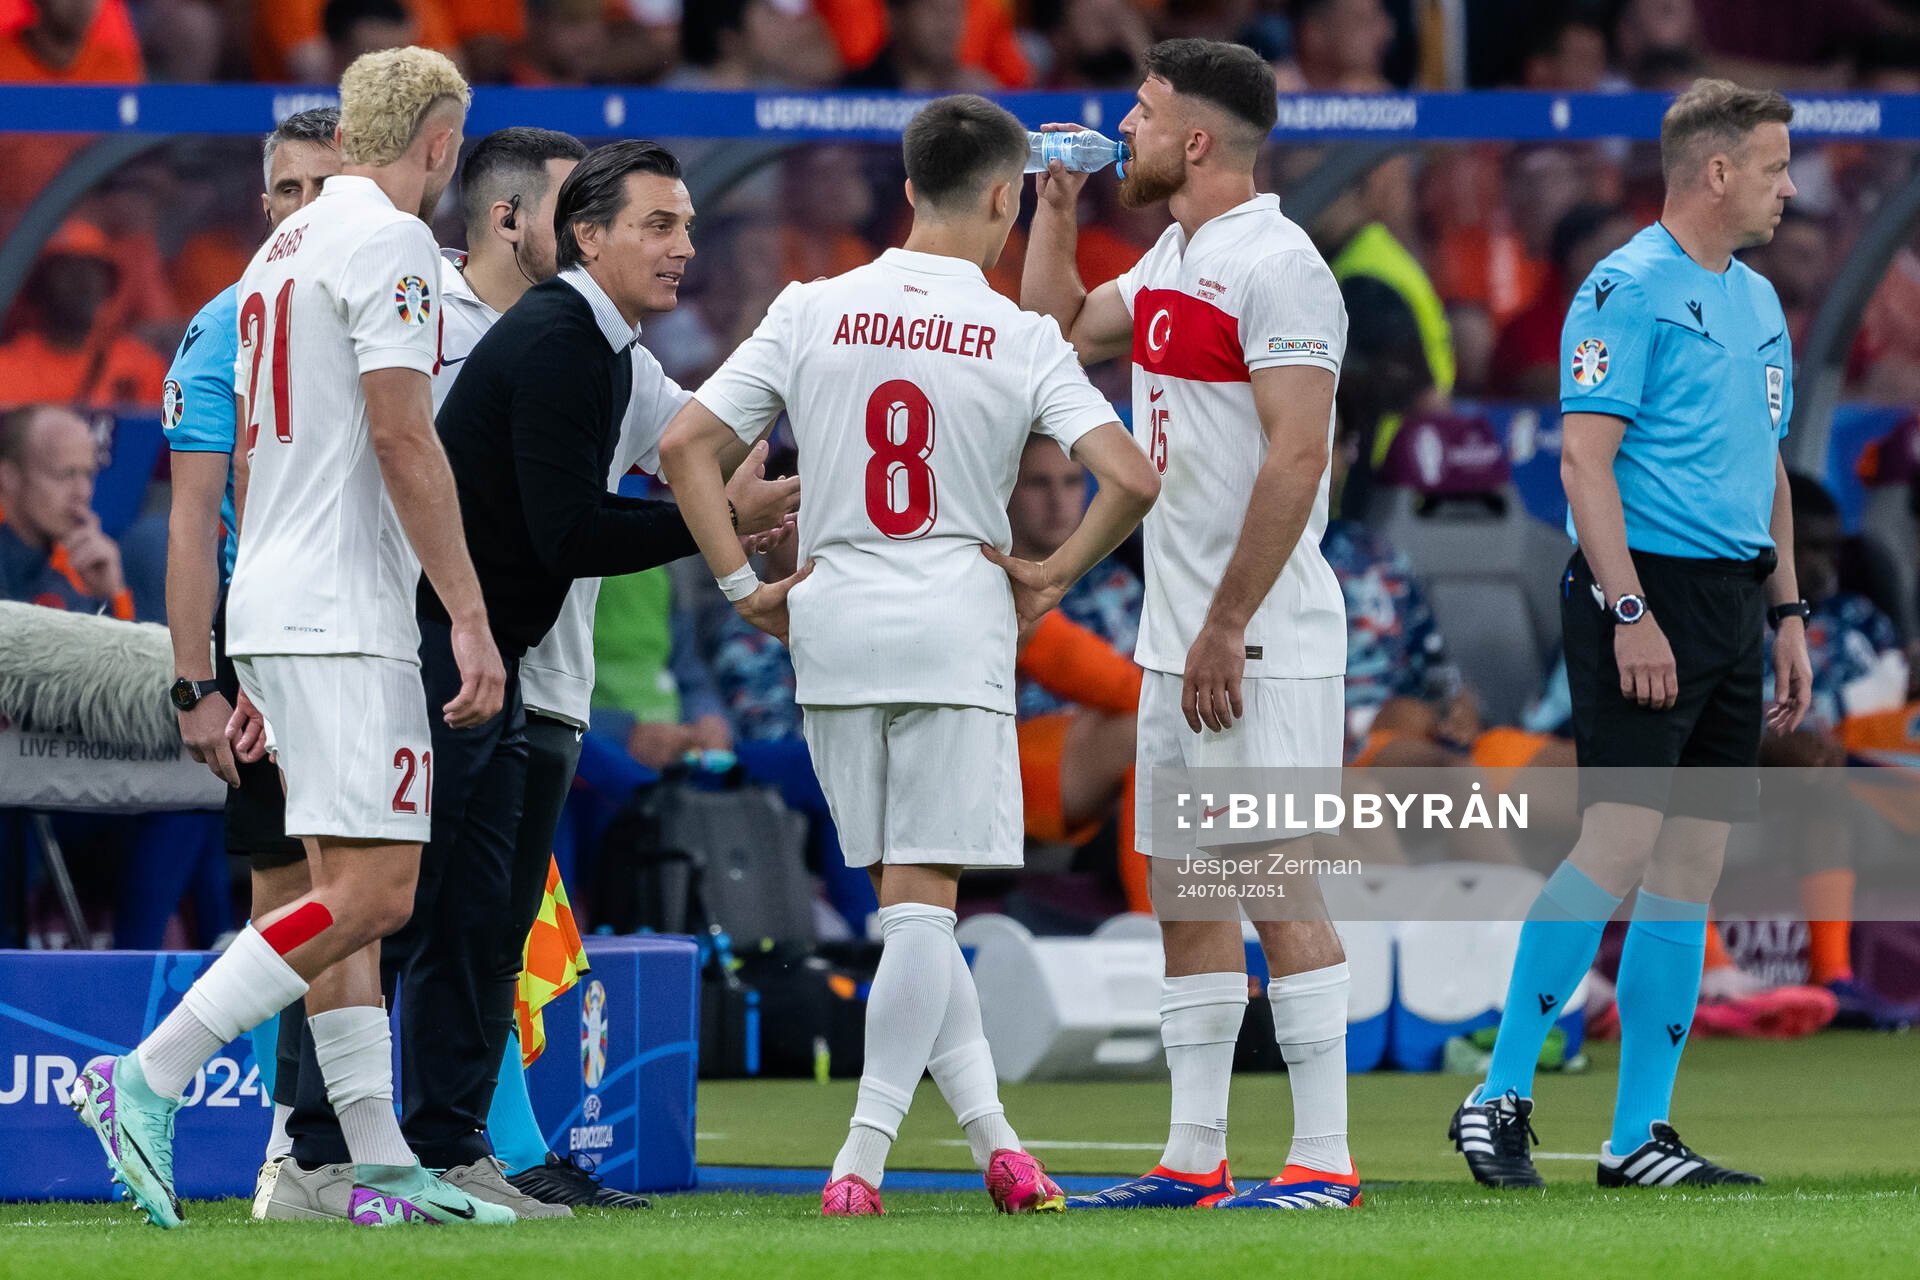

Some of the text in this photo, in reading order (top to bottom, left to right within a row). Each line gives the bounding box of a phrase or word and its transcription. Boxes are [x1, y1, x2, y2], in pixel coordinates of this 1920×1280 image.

[832, 313, 997, 360] ARDAGÜLER
[1268, 341, 1329, 351] FOUNDATION
[239, 278, 296, 458] 21
[865, 379, 937, 541] 8
[1149, 408, 1169, 475] 15
[20, 738, 58, 757] LIVE
[392, 747, 431, 816] 21
[570, 1125, 613, 1151] EURO2024
